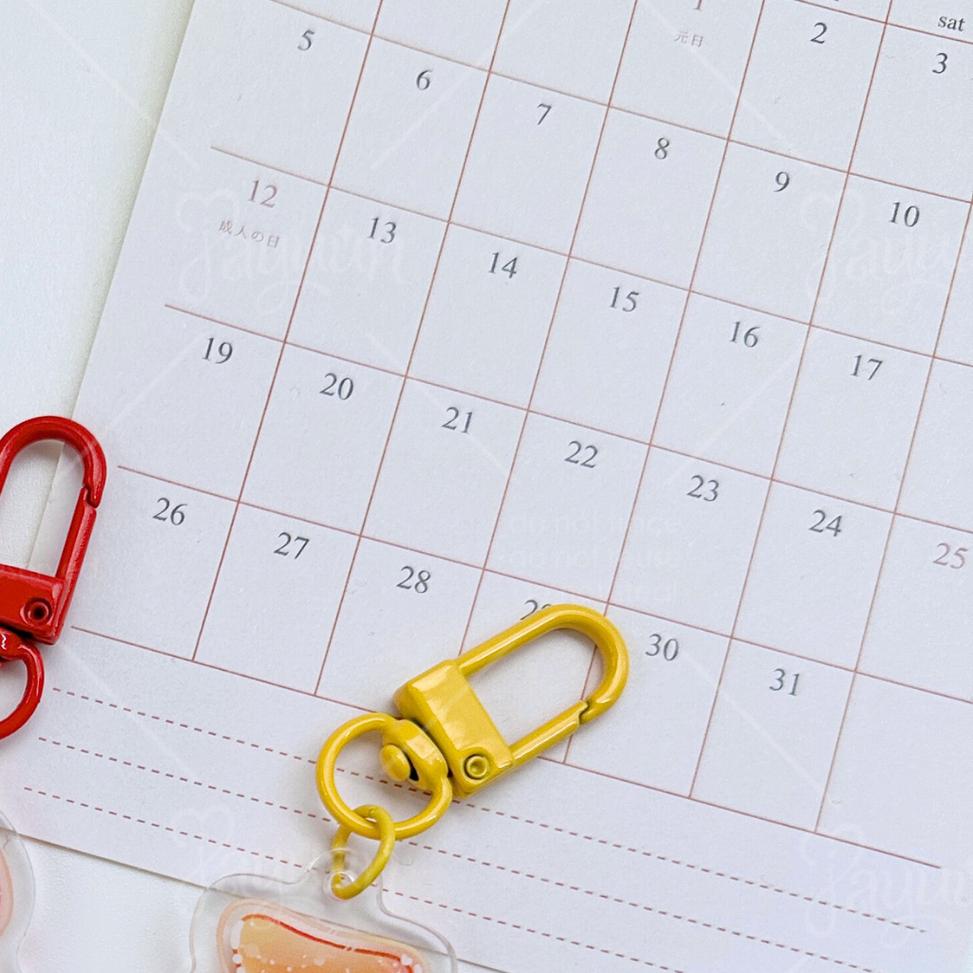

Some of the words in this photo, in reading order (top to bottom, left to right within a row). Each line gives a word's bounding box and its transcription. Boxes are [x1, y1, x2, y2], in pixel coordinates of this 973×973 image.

[810, 21, 828, 45] 2
[937, 15, 966, 32] sat
[297, 28, 315, 51] 5
[932, 52, 949, 75] 3
[415, 69, 432, 91] 6
[537, 102, 553, 125] 7
[654, 136, 671, 160] 8
[247, 179, 279, 208] 12
[775, 171, 791, 193] 9
[890, 201, 921, 228] 10
[217, 219, 281, 249] 成人の日
[367, 216, 398, 245] 13
[489, 251, 518, 279] 14
[610, 286, 640, 313] 15
[730, 320, 759, 348] 16
[203, 337, 234, 365] 19
[851, 354, 883, 381] 17
[320, 372, 355, 401] 20
[441, 406, 473, 434] 21
[564, 440, 599, 469] 22
[687, 474, 720, 502] 23
[152, 496, 187, 526] 26
[809, 509, 843, 538] 24
[273, 531, 310, 560] 27
[933, 542, 968, 570] 25
[395, 565, 432, 594] 28
[645, 633, 680, 662] 30
[769, 667, 800, 697] 31
